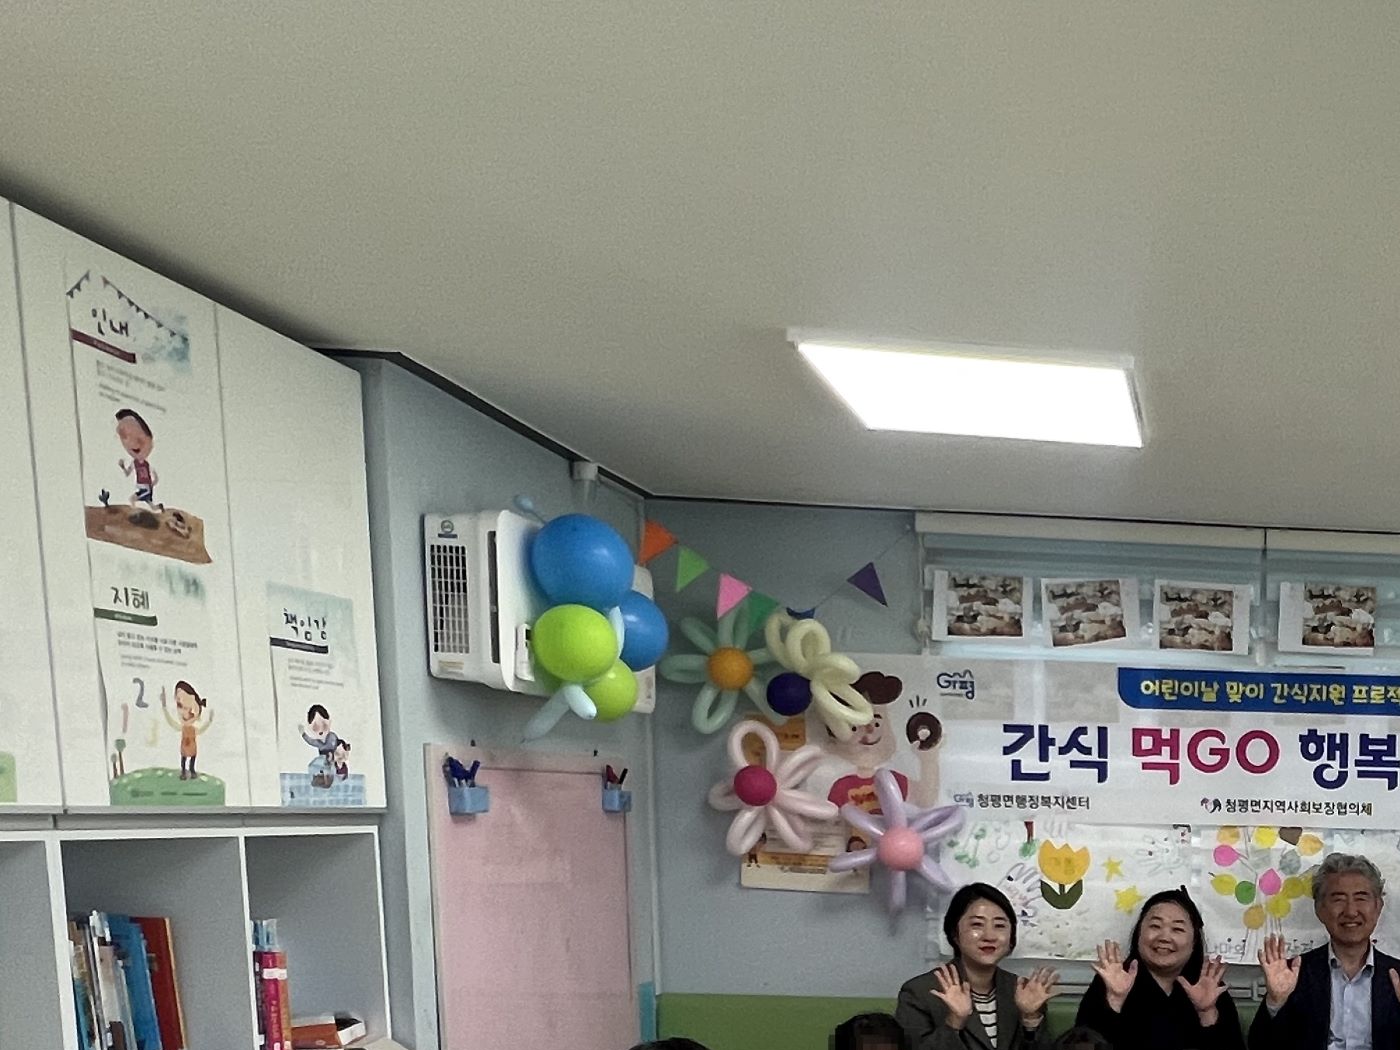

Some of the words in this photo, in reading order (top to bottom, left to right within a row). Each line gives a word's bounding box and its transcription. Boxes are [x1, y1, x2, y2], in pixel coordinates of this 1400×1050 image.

[91, 308, 129, 337] 인내
[110, 586, 150, 610] 지혜
[283, 607, 327, 641] 책임감
[1140, 679, 1219, 703] 어린이날
[1225, 681, 1264, 704] 맞이
[1270, 682, 1346, 706] 간식지원
[1002, 723, 1108, 784] 간식
[1131, 726, 1280, 785] 먹GO
[1298, 728, 1400, 791] 행복
[977, 793, 1090, 810] 청평면행정복지센터
[1225, 798, 1373, 816] 청평면지역사회보장협의체
